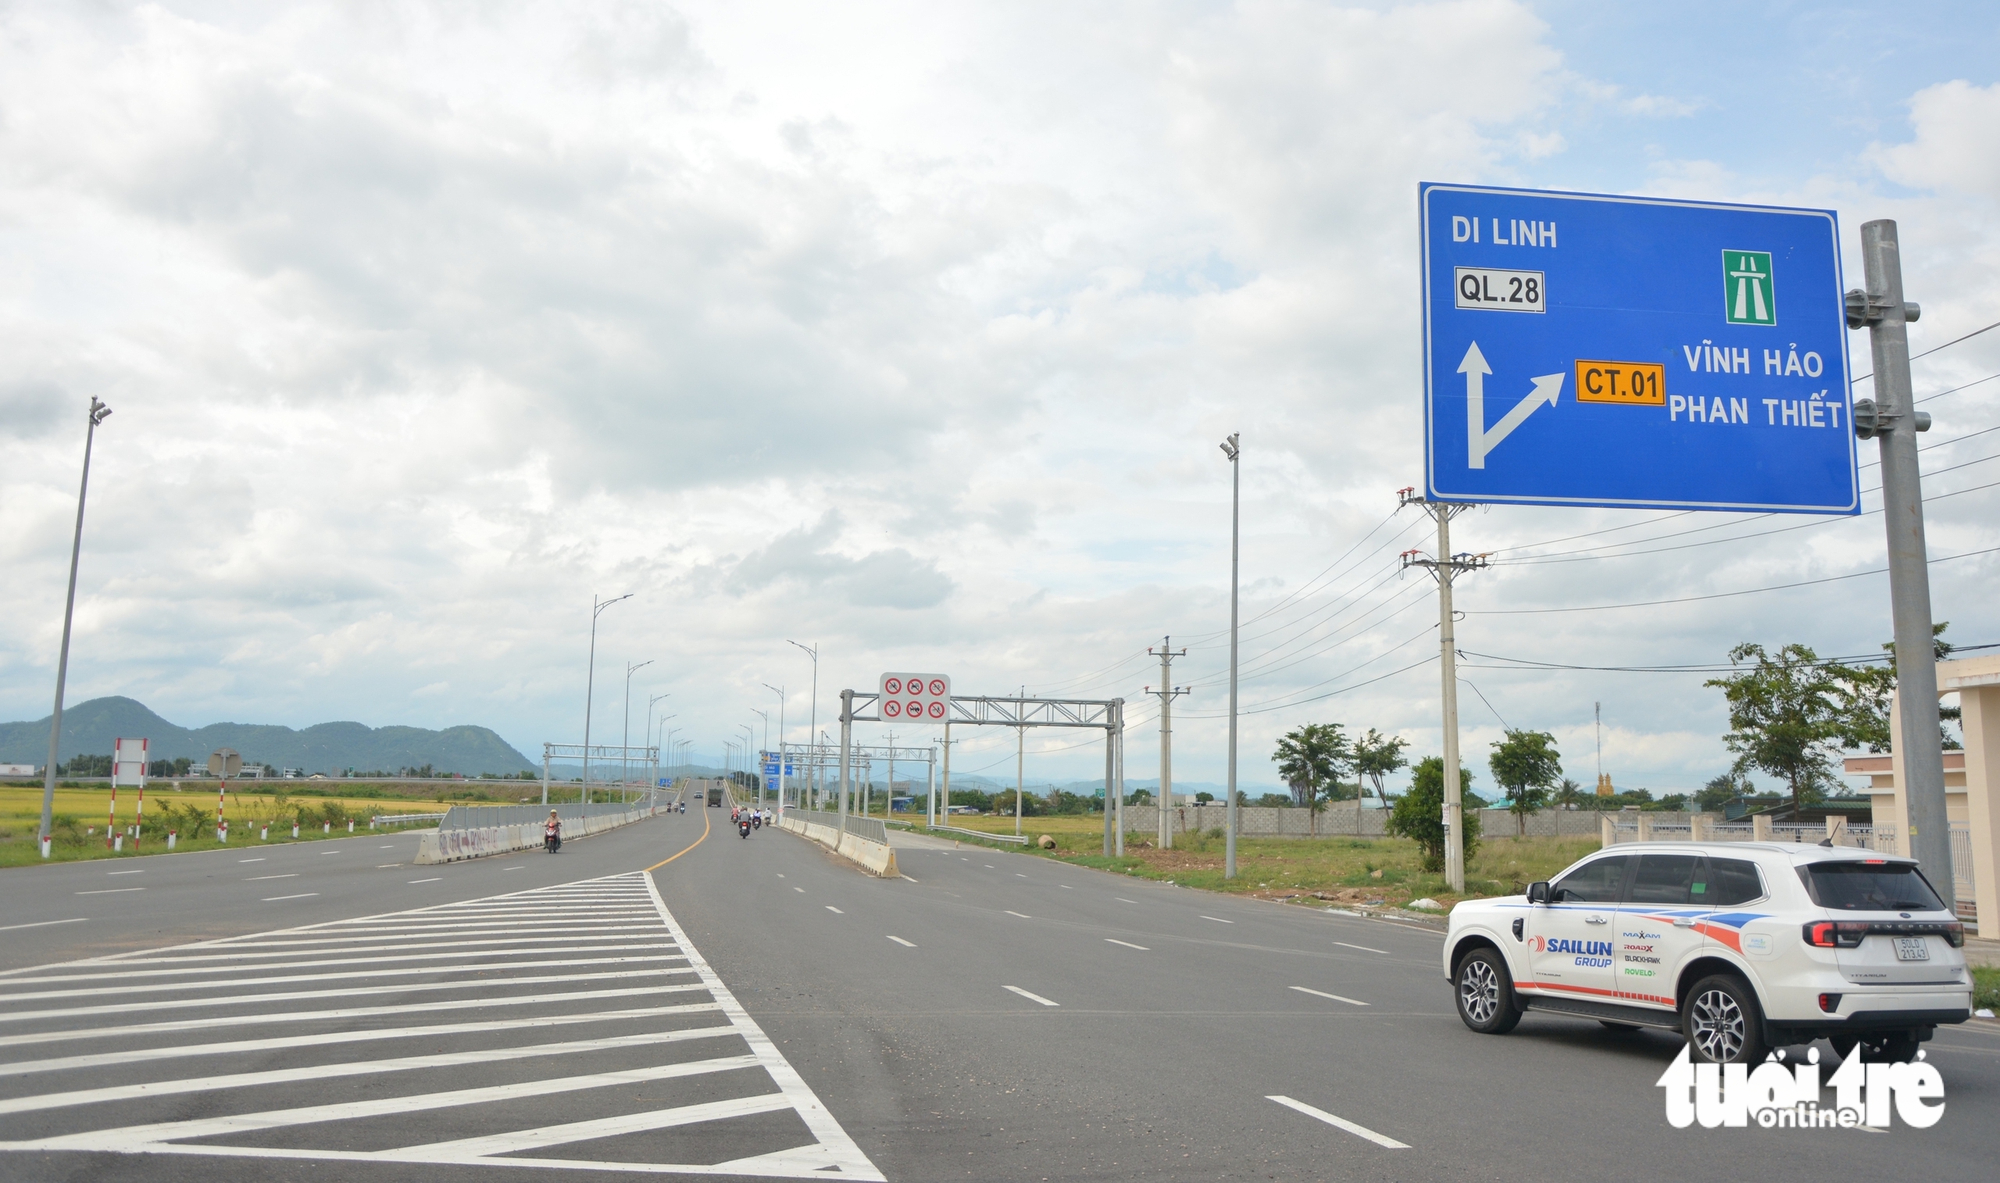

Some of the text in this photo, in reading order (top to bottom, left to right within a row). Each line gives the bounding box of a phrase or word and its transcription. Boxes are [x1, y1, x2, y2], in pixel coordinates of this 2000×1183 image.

[1452, 215, 1557, 248] DI LINH
[1459, 273, 1540, 304] QL.28
[1682, 339, 1823, 378] VĨNH HẢO
[1584, 367, 1658, 398] CT.01
[1670, 389, 1842, 429] PHAN THIẾT
[1623, 930, 1661, 940] MAXAM
[1547, 938, 1612, 956] SAILUN
[1623, 944, 1654, 953] ROADX
[1574, 956, 1613, 968] GROUP
[1624, 955, 1661, 965] BLACKHAWK
[1624, 968, 1653, 977] ROVELO
